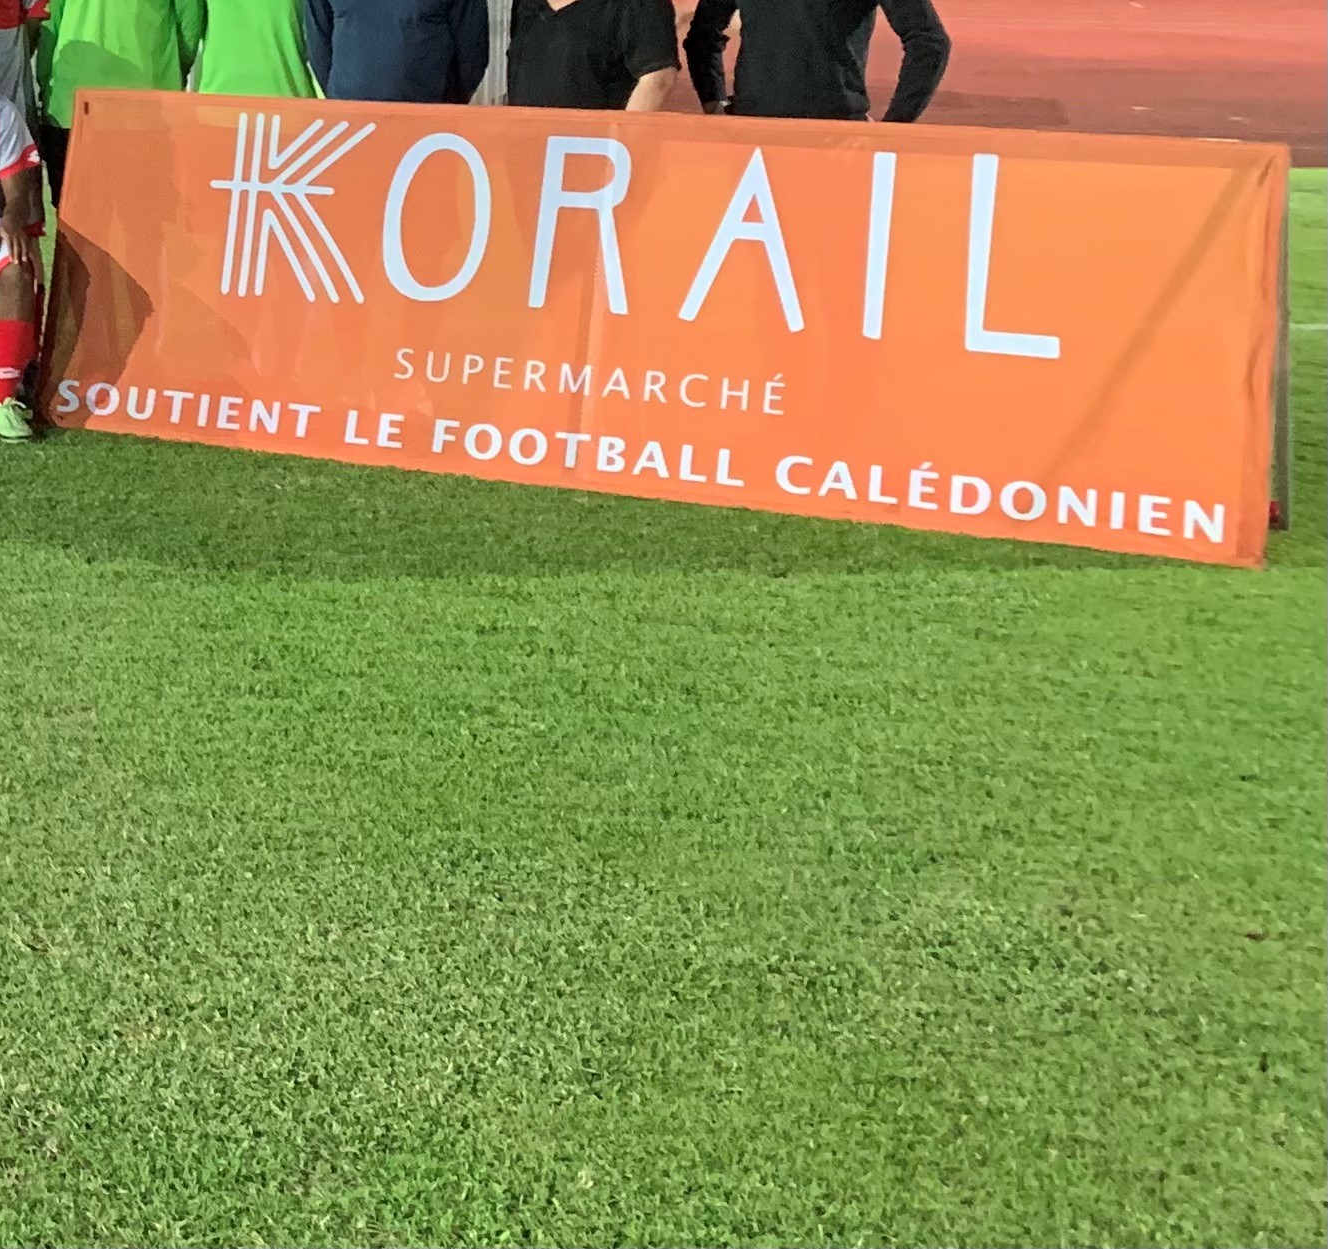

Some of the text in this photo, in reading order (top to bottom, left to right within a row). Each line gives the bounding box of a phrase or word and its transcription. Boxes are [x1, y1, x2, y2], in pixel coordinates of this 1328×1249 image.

[209, 112, 1061, 360] KORAIL
[56, 380, 1226, 544] SOUTIENT LE FOOTBALL CALÉDONIEN
[395, 348, 788, 415] SUPERMARCHÉ
